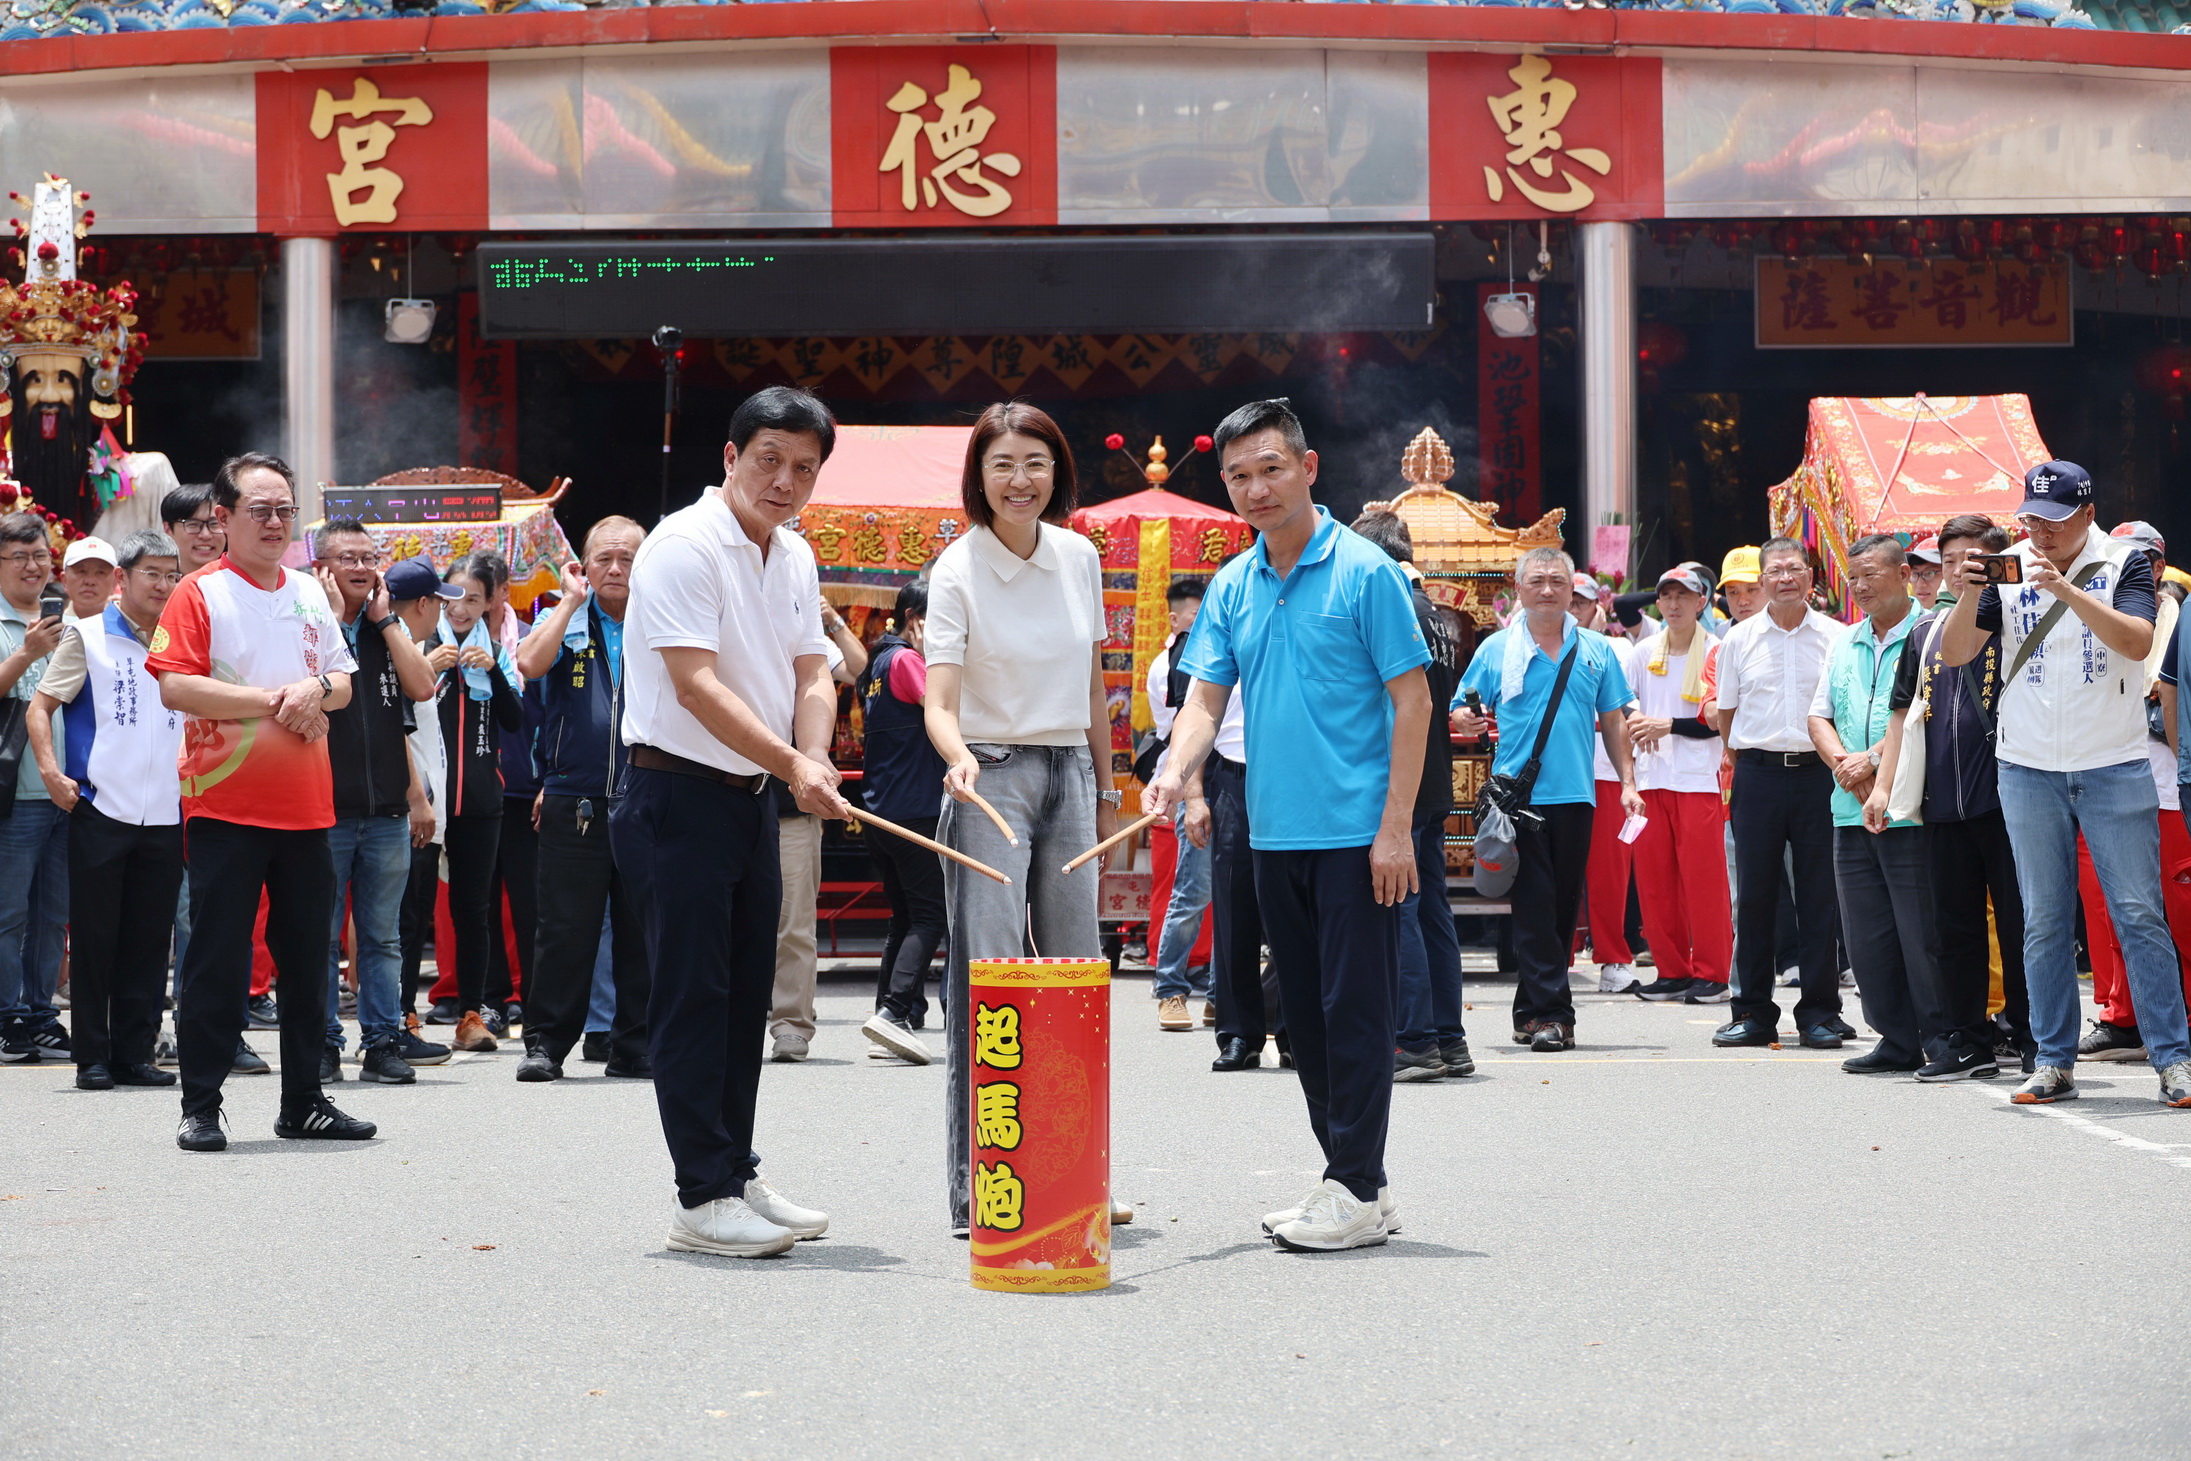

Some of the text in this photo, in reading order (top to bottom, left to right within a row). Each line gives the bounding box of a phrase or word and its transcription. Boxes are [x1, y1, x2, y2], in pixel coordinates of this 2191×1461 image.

[309, 54, 1611, 227] 惠 德 宮
[2031, 475, 2050, 493] 佳
[812, 523, 931, 566] 惠德宮
[294, 600, 324, 624] 新竹
[303, 623, 320, 677] 都城
[974, 1001, 1024, 1232] 起馬炮
